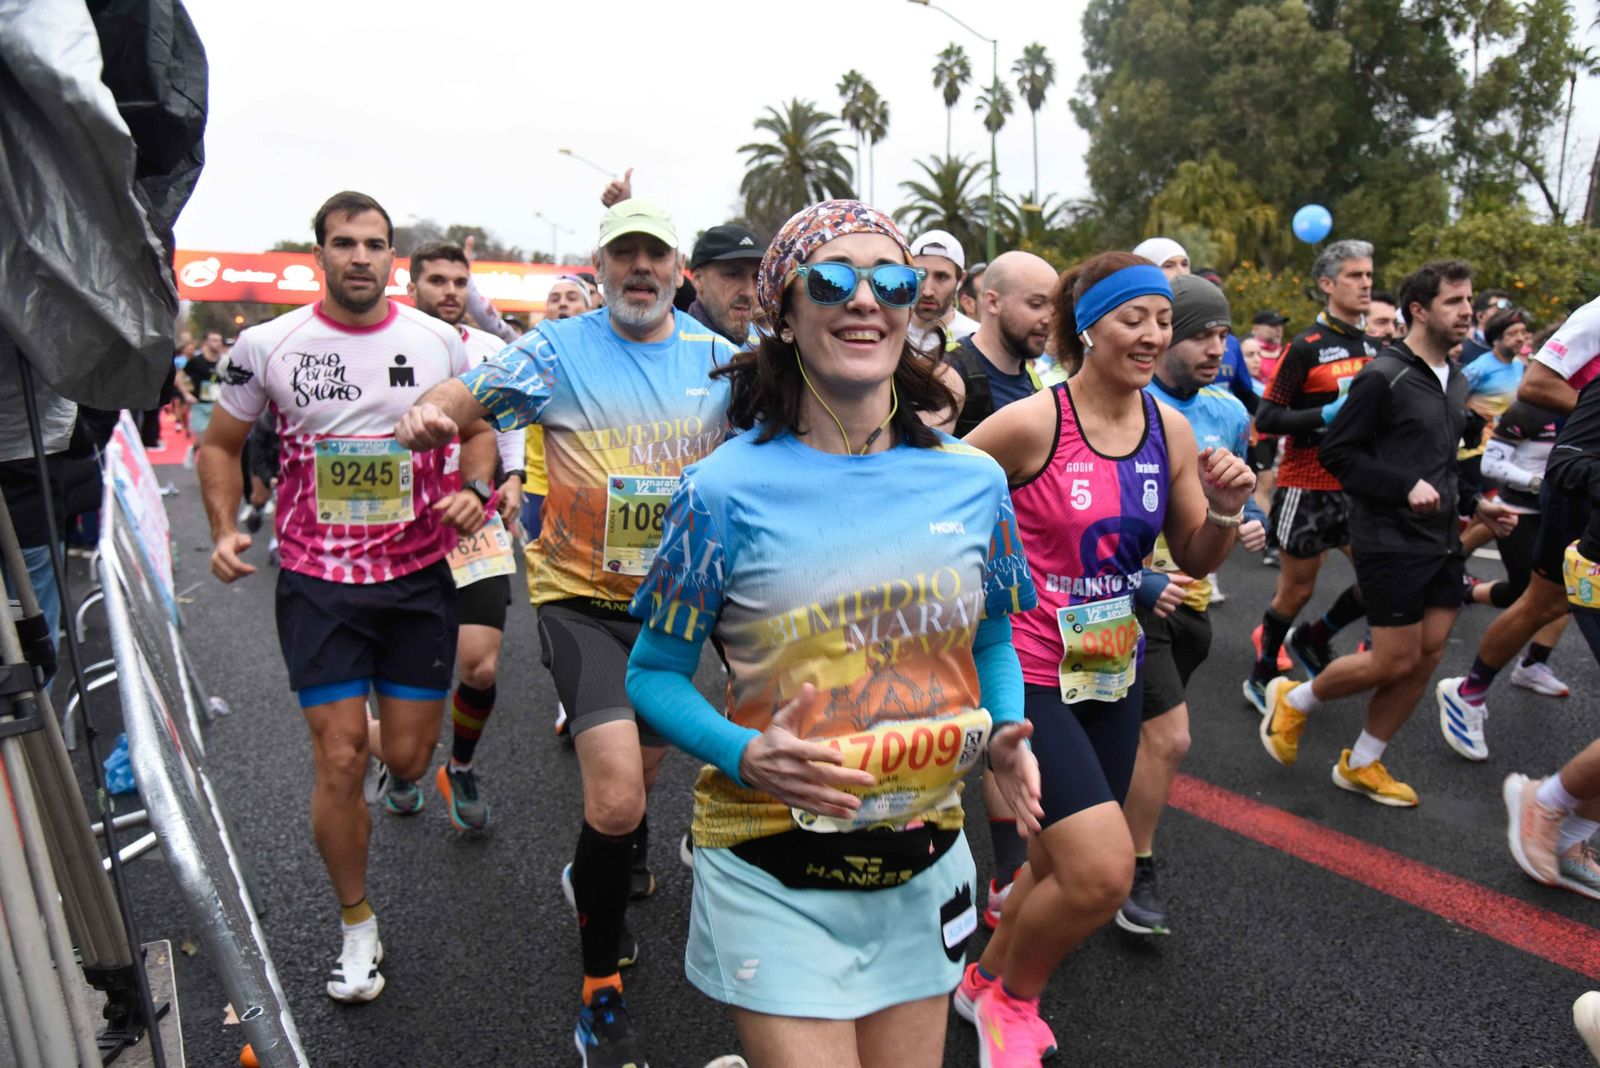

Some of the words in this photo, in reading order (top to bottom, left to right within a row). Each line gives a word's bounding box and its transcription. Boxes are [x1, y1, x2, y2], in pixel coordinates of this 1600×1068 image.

[609, 415, 703, 450] MEDIO
[330, 461, 394, 487] 9245
[1070, 479, 1092, 510] 5
[810, 566, 962, 634] MEDIO
[1045, 573, 1103, 597] BRAIN
